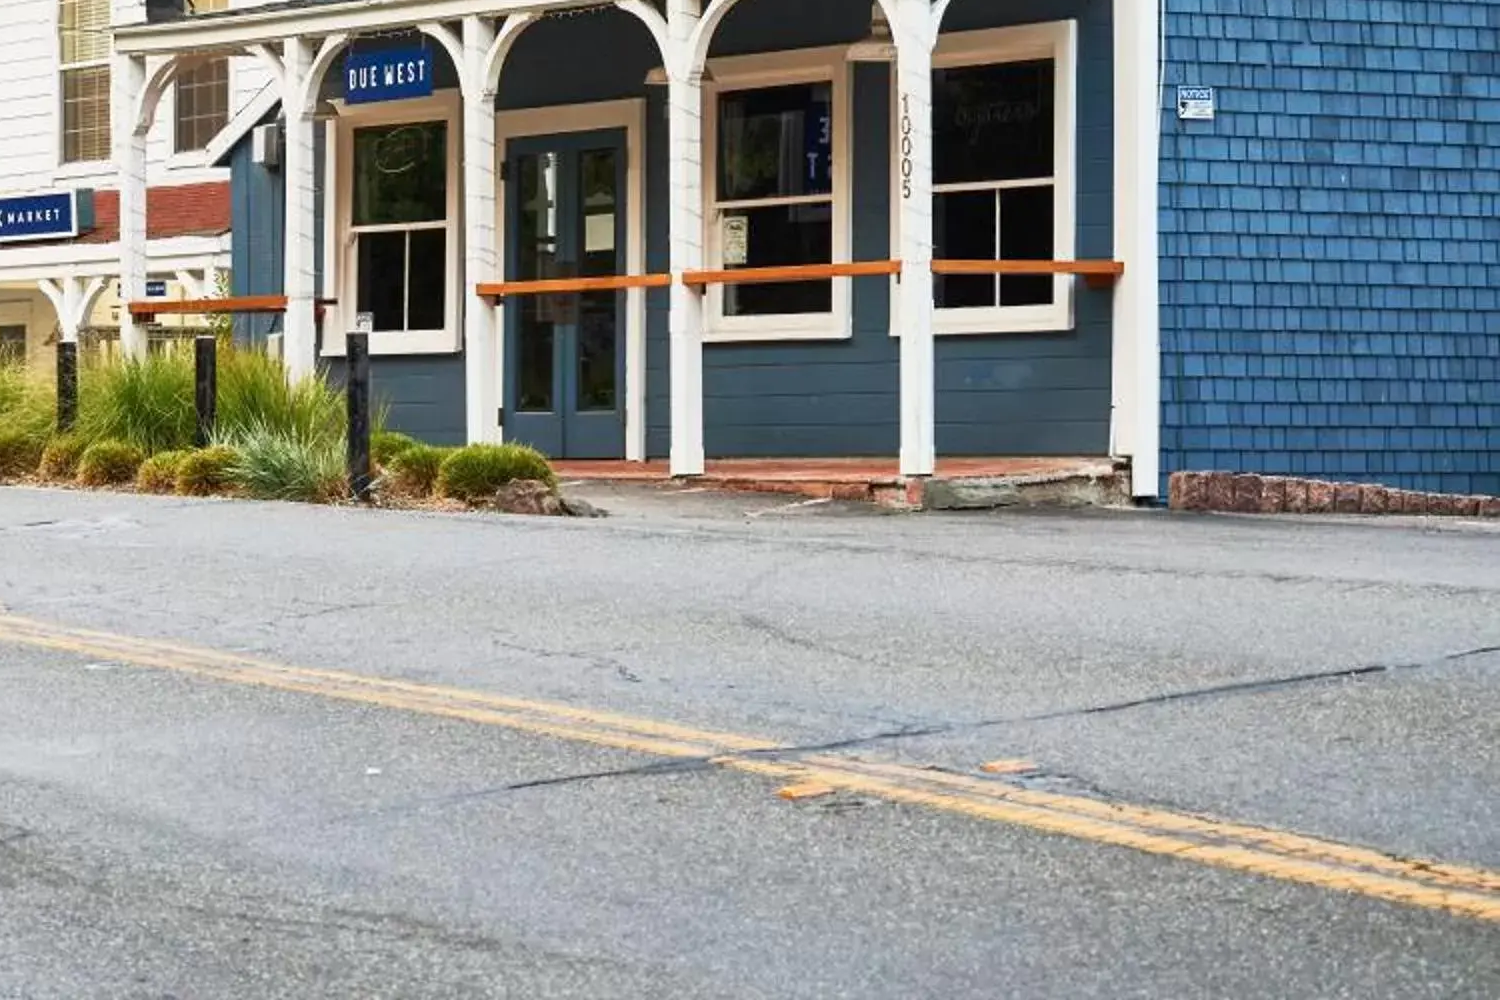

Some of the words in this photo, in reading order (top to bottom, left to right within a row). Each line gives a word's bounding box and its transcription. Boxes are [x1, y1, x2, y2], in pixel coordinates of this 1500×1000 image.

[349, 65, 377, 91] DUE
[384, 60, 425, 86] WEST
[7, 208, 60, 225] MARKET
